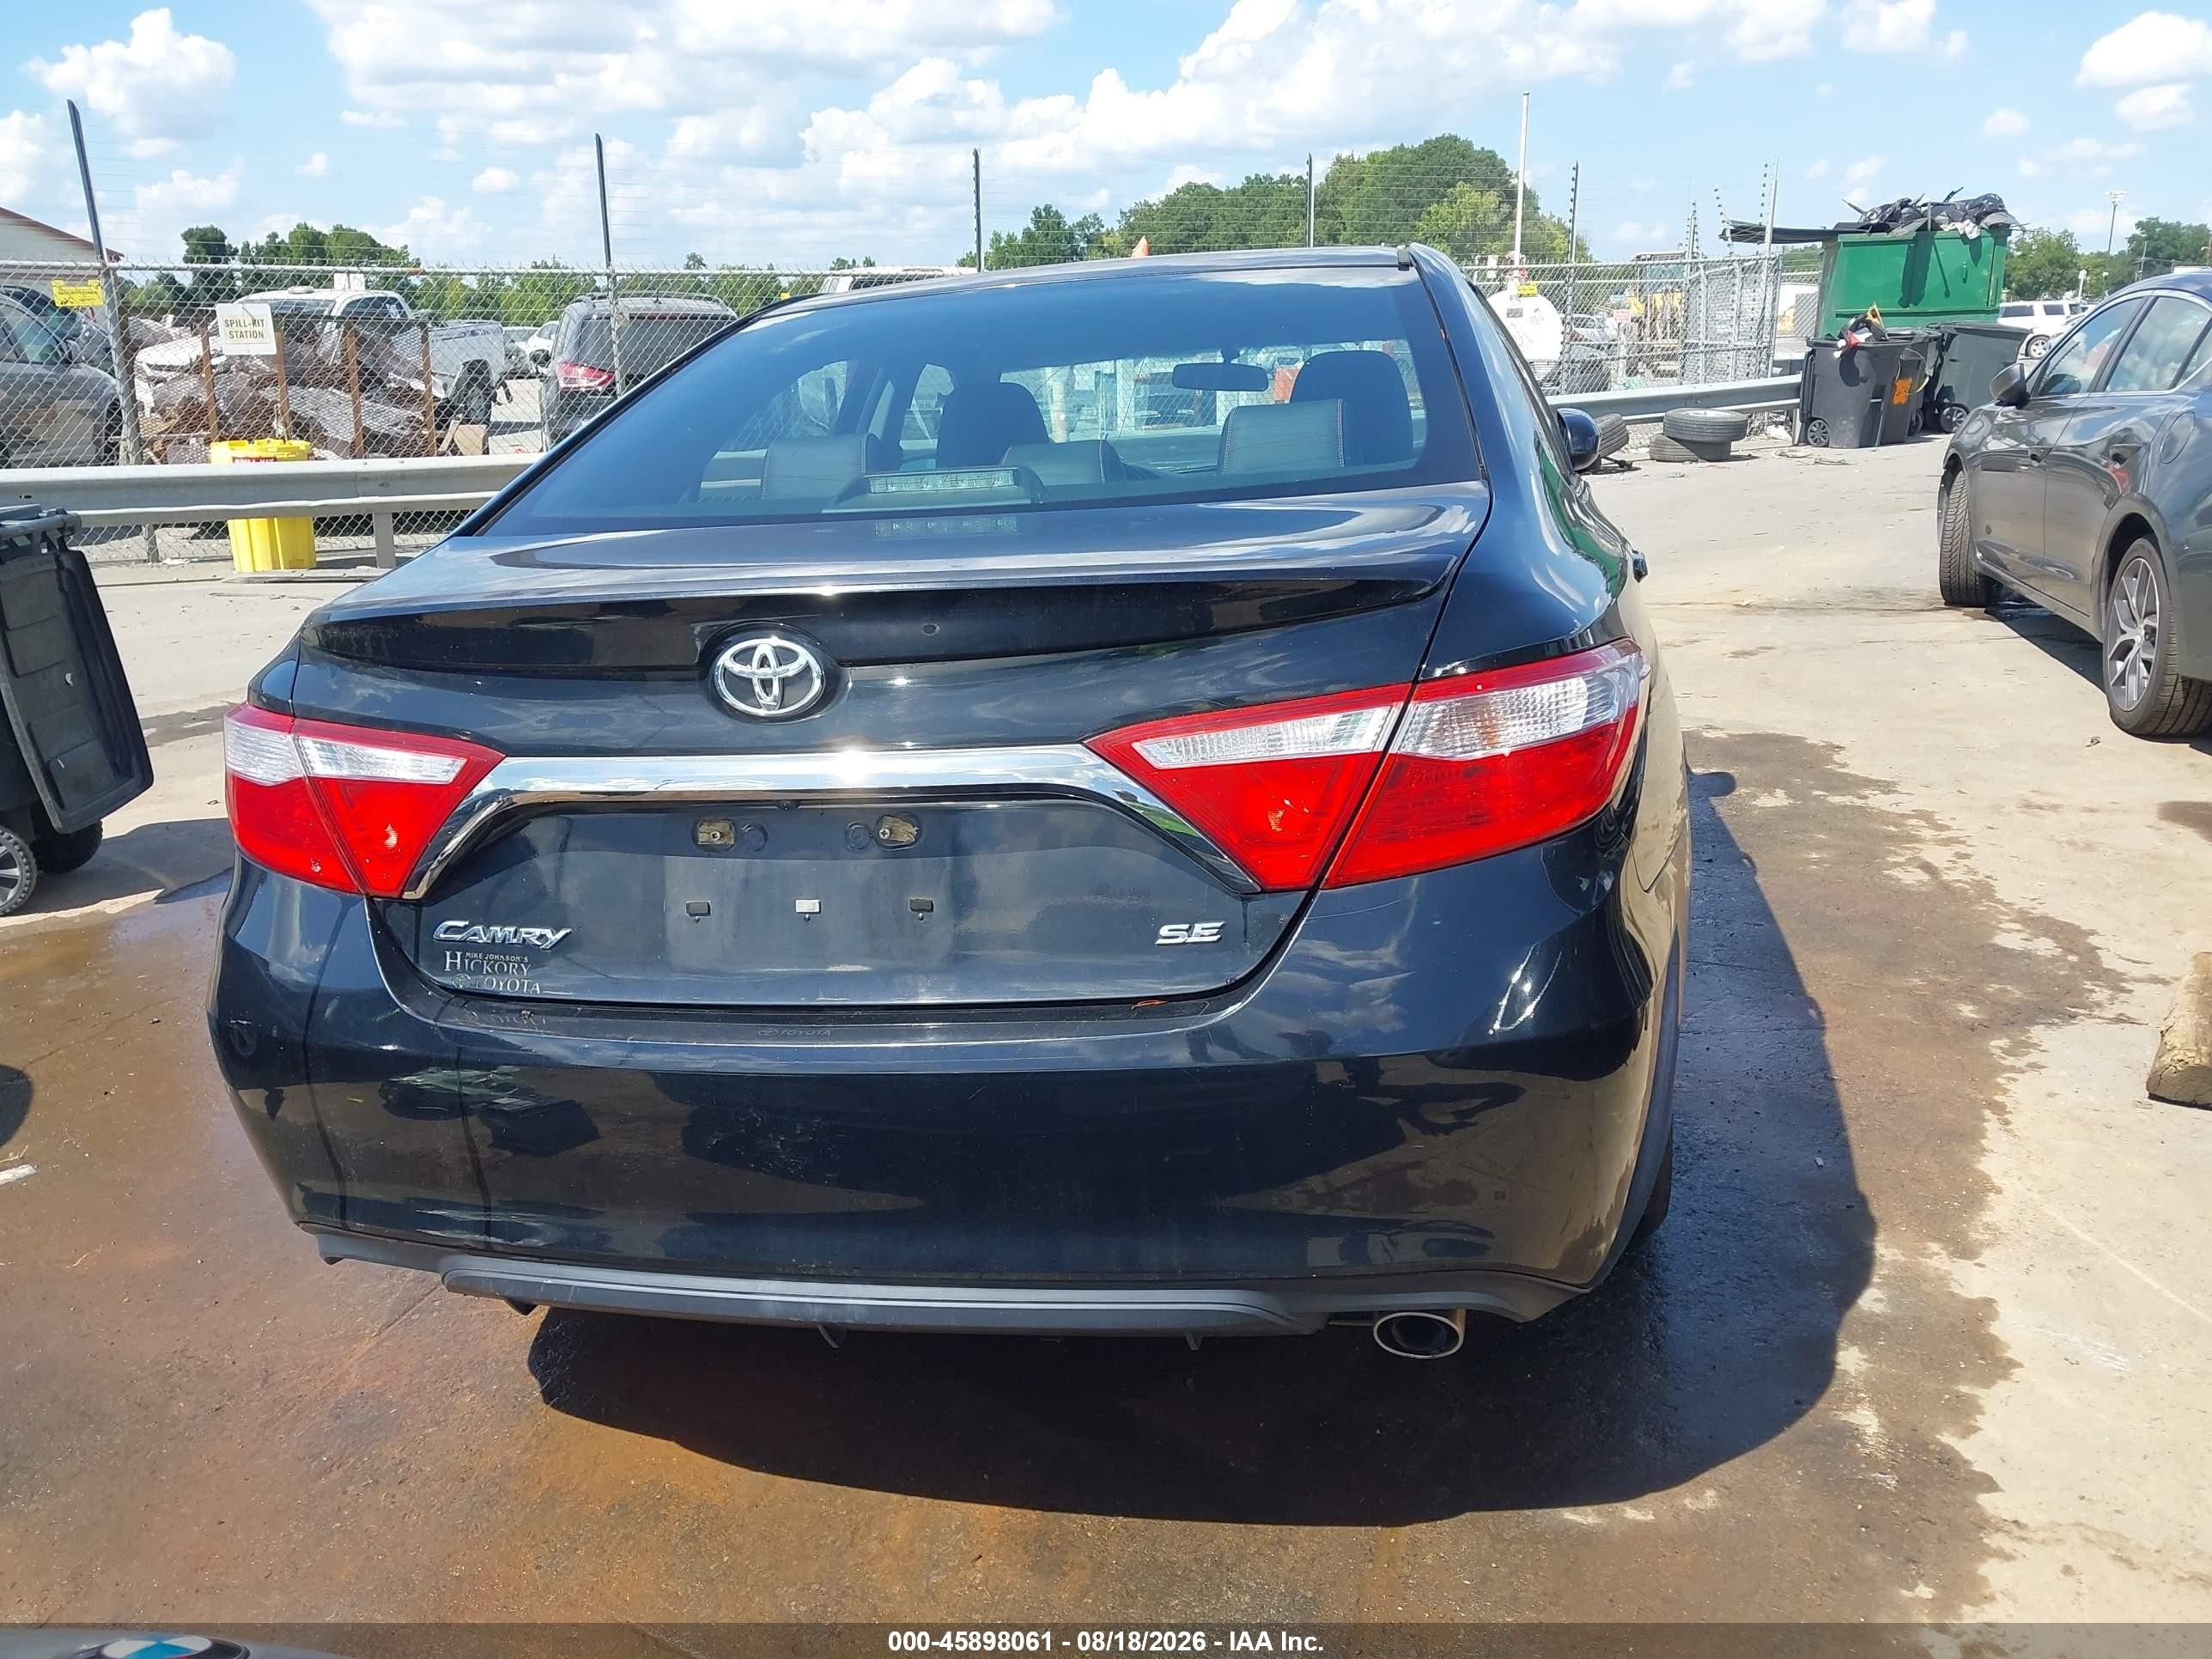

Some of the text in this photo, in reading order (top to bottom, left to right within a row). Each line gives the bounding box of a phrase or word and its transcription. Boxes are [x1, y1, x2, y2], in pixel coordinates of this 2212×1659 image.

[224, 319, 265, 328] SPILL-KIT
[228, 330, 264, 339] STATION
[433, 921, 573, 950] CAMRY
[1154, 920, 1225, 945] SE
[444, 951, 532, 976] HICKORY
[465, 951, 483, 960] MIKE
[474, 975, 541, 994] TOYOTA
